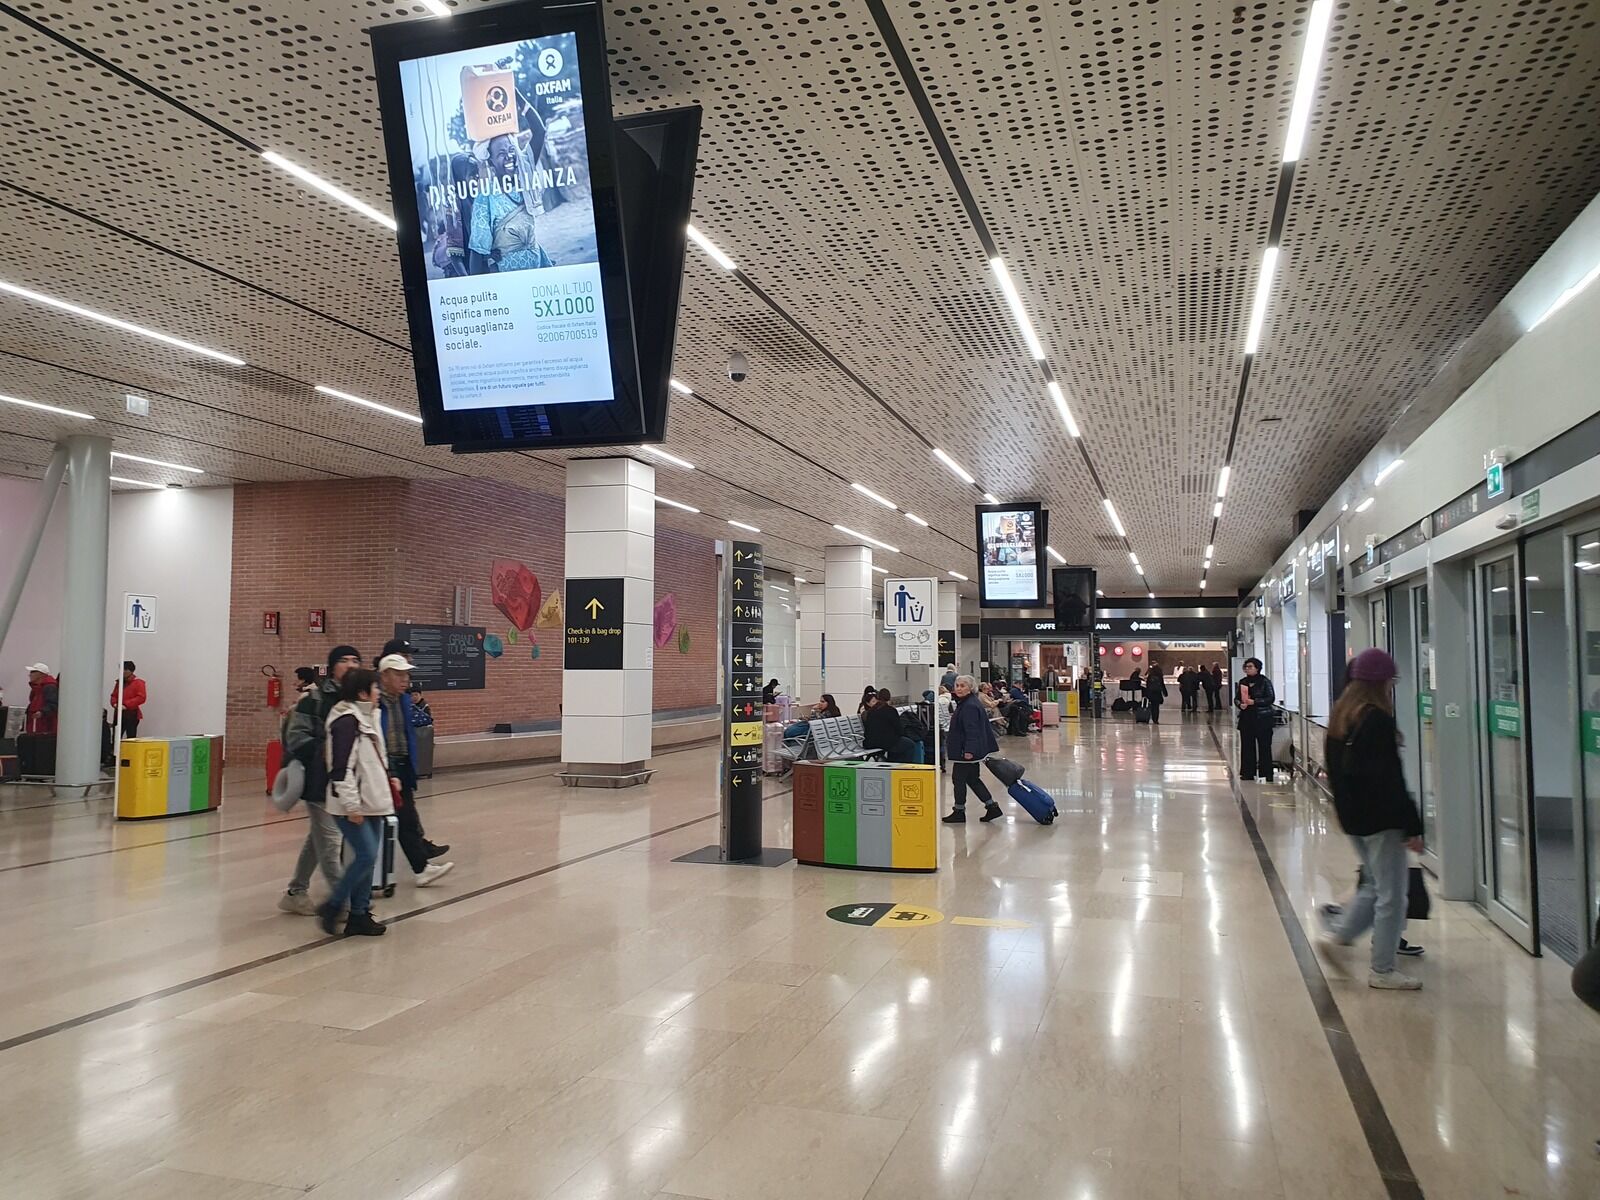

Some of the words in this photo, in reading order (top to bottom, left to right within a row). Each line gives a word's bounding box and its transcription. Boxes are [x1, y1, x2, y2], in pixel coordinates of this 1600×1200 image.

[535, 78, 571, 96] OXFAM
[546, 96, 563, 105] Italia
[487, 112, 512, 126] OXFAM
[429, 166, 577, 207] DISUGUAGLIANZA
[532, 284, 560, 298] DONA
[562, 283, 572, 295] IL
[572, 280, 593, 294] TUO
[440, 295, 469, 307] Acqua
[470, 291, 498, 306] pulita
[534, 295, 595, 318] 5X1000
[441, 308, 482, 323] significa
[484, 307, 510, 317] meno
[443, 321, 514, 337] disuguaglianza
[537, 328, 598, 343] 92006700519
[445, 338, 482, 351] sociale.
[567, 627, 591, 635] Check-in
[591, 627, 596, 635] &
[597, 627, 608, 636] bag
[608, 627, 622, 636] drop
[567, 636, 590, 644] 101-139
